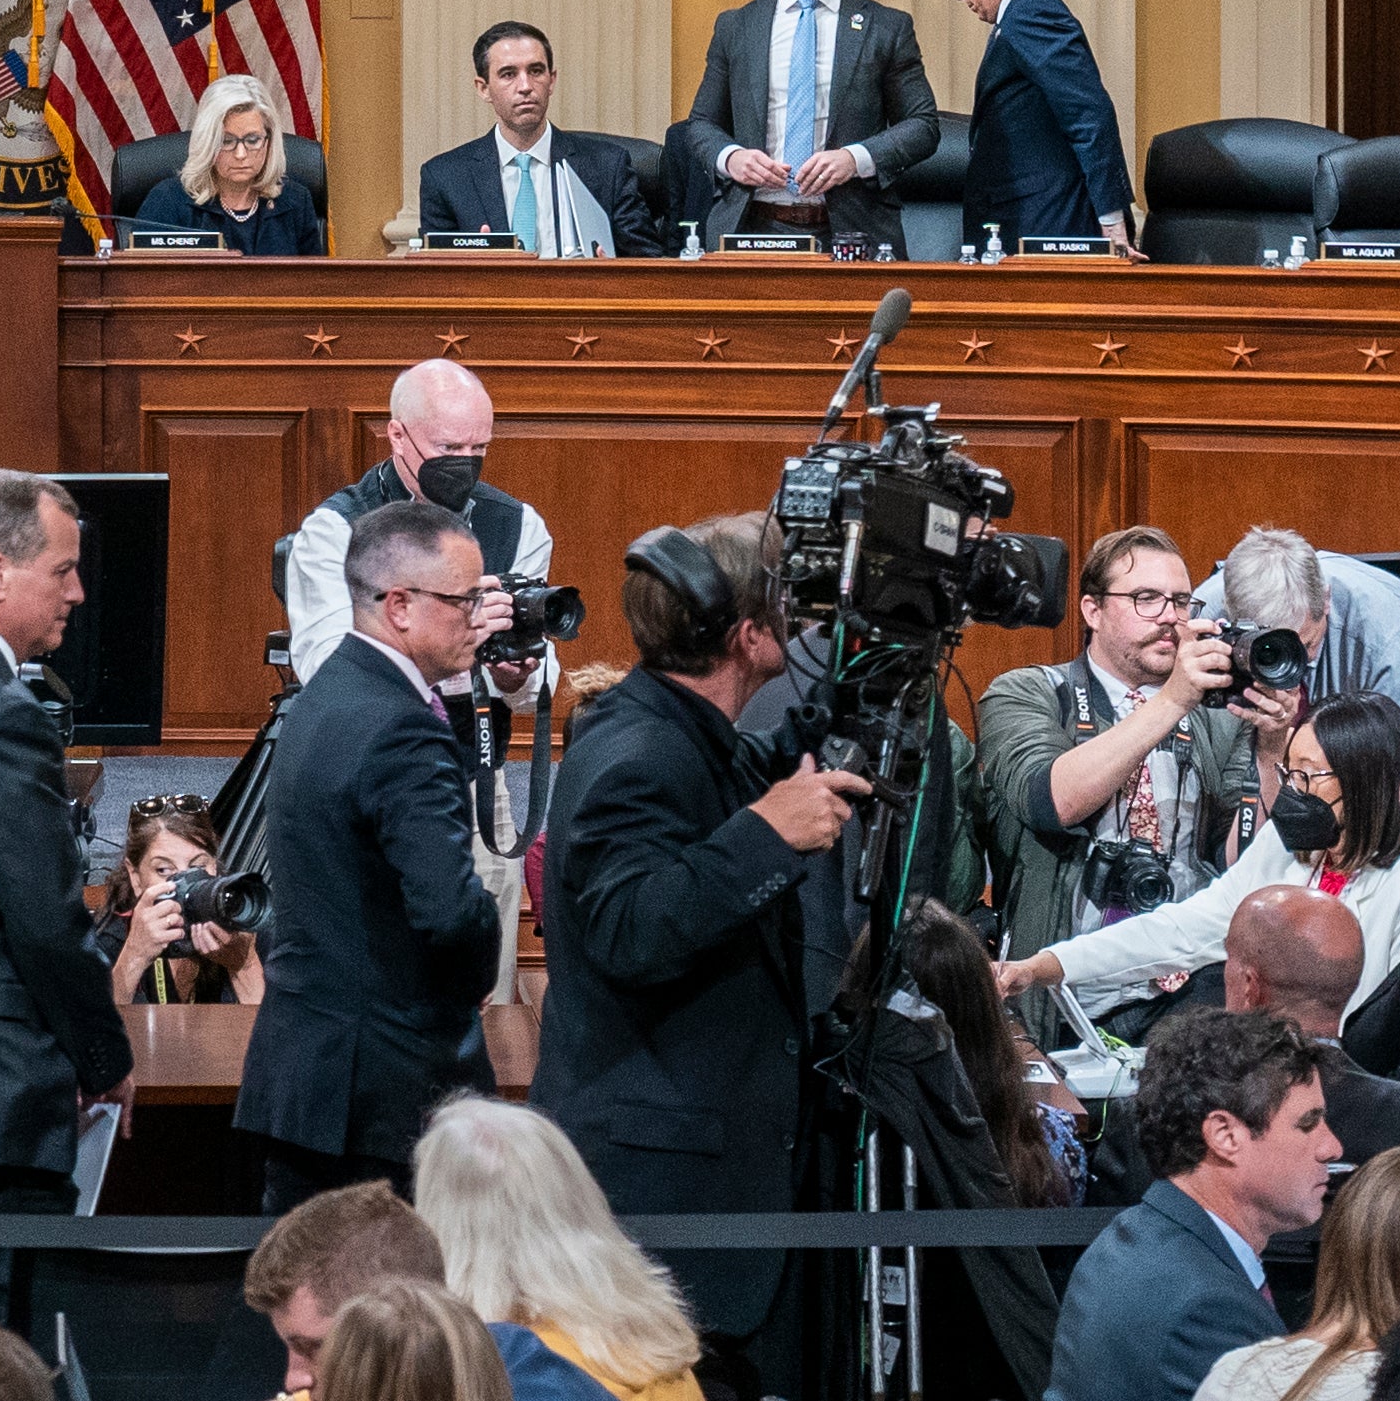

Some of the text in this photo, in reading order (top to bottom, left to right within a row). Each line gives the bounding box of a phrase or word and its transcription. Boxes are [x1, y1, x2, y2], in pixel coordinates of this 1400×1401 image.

[151, 237, 201, 246] MS. CHENEY
[453, 238, 490, 247] COUNSEL
[737, 240, 797, 249] MR. KINZINGER
[1042, 243, 1090, 252] MR. RASKIN
[1342, 248, 1396, 258] MR. AGUILAR
[1075, 686, 1091, 722] SONY
[479, 717, 491, 768] SONY
